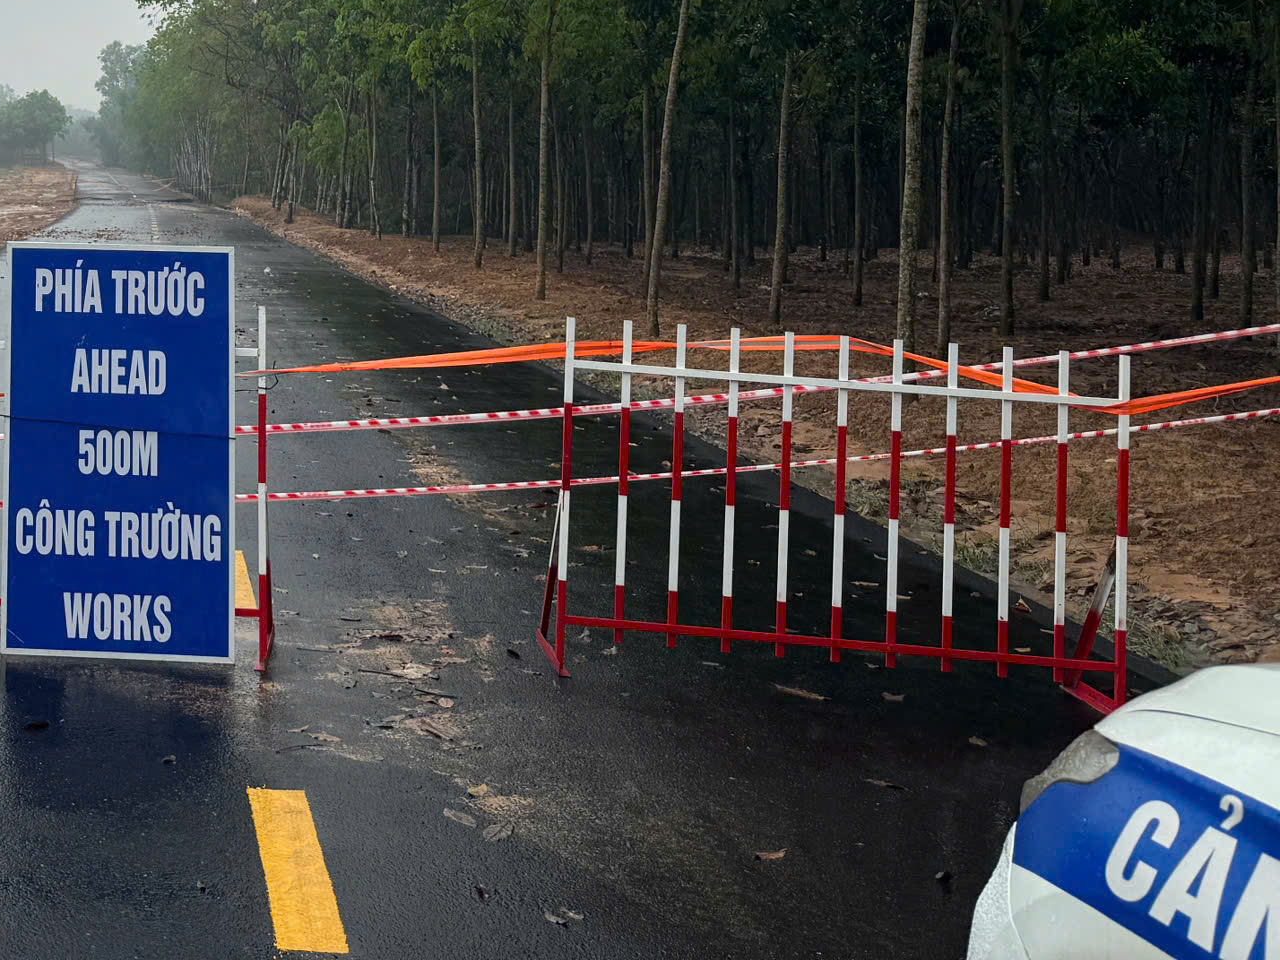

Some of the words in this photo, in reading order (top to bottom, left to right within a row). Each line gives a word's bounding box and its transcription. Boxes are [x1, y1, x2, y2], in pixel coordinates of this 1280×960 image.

[34, 259, 103, 315] PHÍA
[111, 261, 206, 317] TRƯỚC
[70, 348, 167, 396] AHEAD
[78, 429, 158, 477] 500M
[15, 499, 95, 557] CÔNG
[104, 501, 221, 562] TRƯỜNG
[63, 591, 172, 643] WORKS
